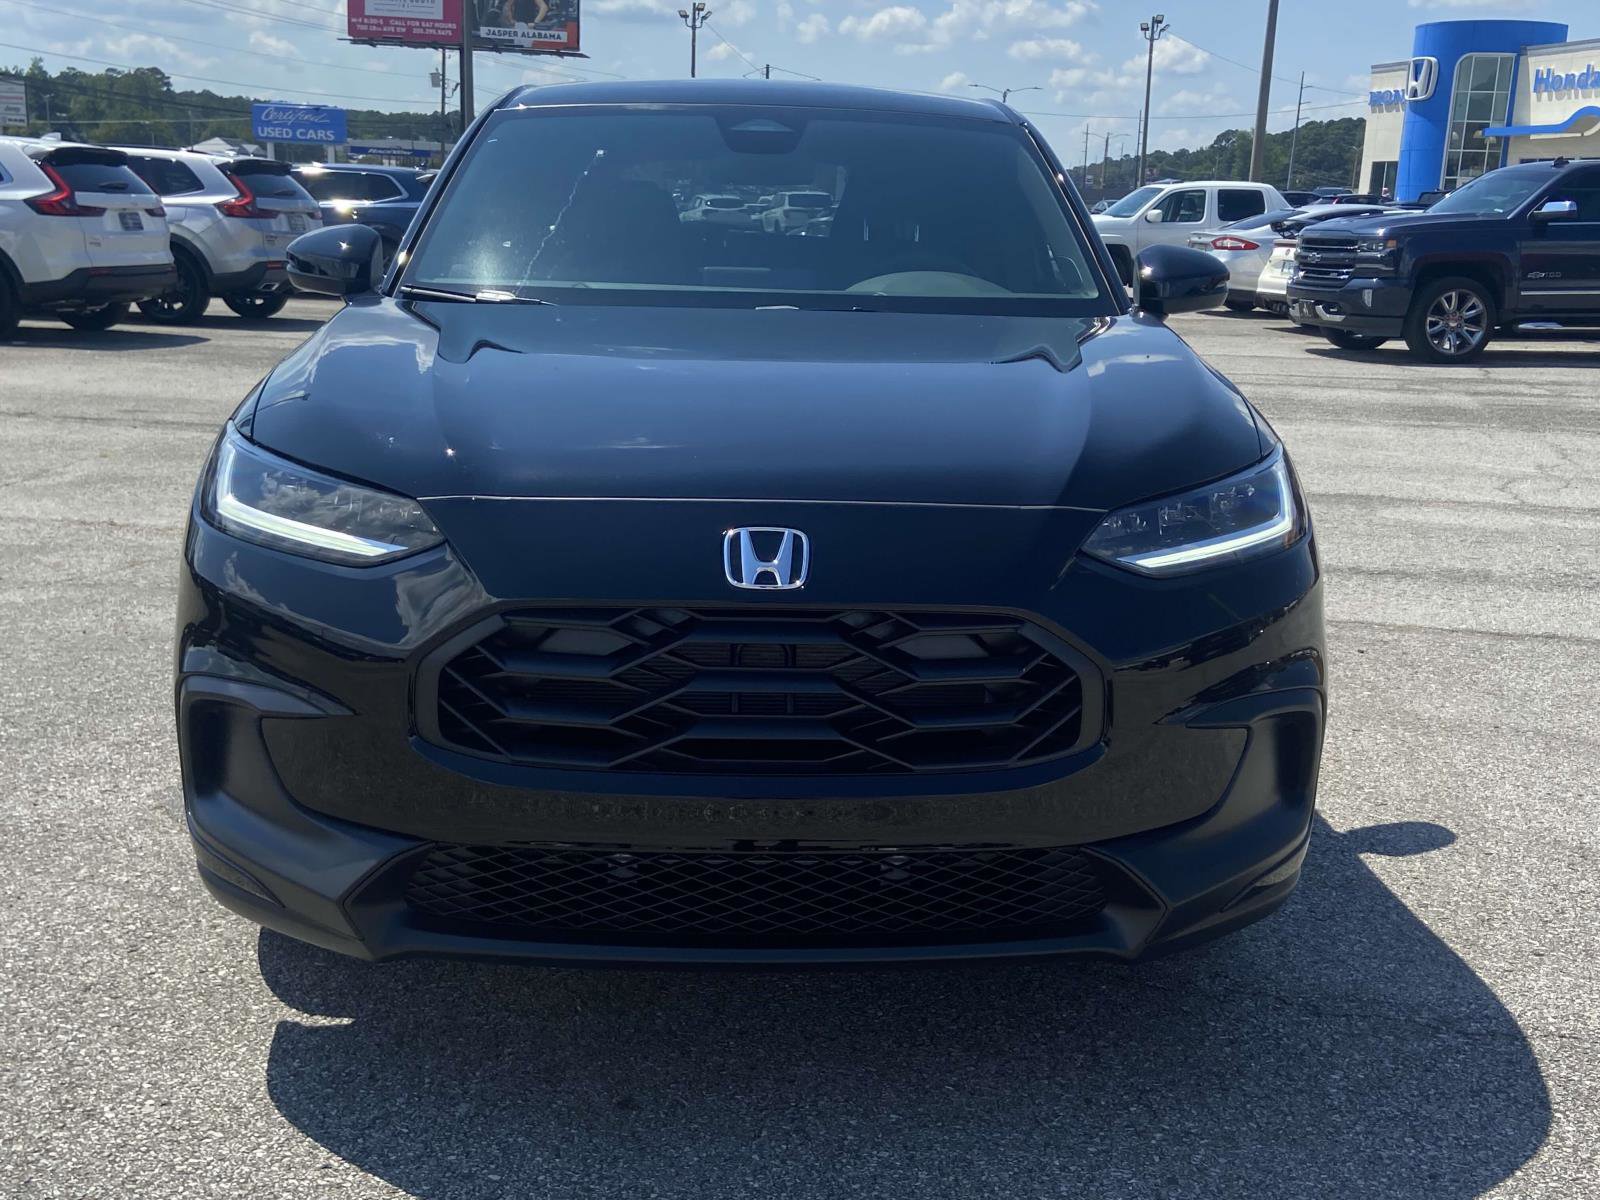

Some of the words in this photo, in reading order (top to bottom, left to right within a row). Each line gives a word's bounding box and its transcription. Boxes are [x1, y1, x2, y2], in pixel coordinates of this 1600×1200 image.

[486, 28, 519, 38] JASPER
[521, 31, 562, 40] ALABAMA
[1368, 88, 1406, 106] HON
[261, 107, 330, 126] Certified
[257, 126, 292, 138] USED
[296, 128, 335, 141] CARS
